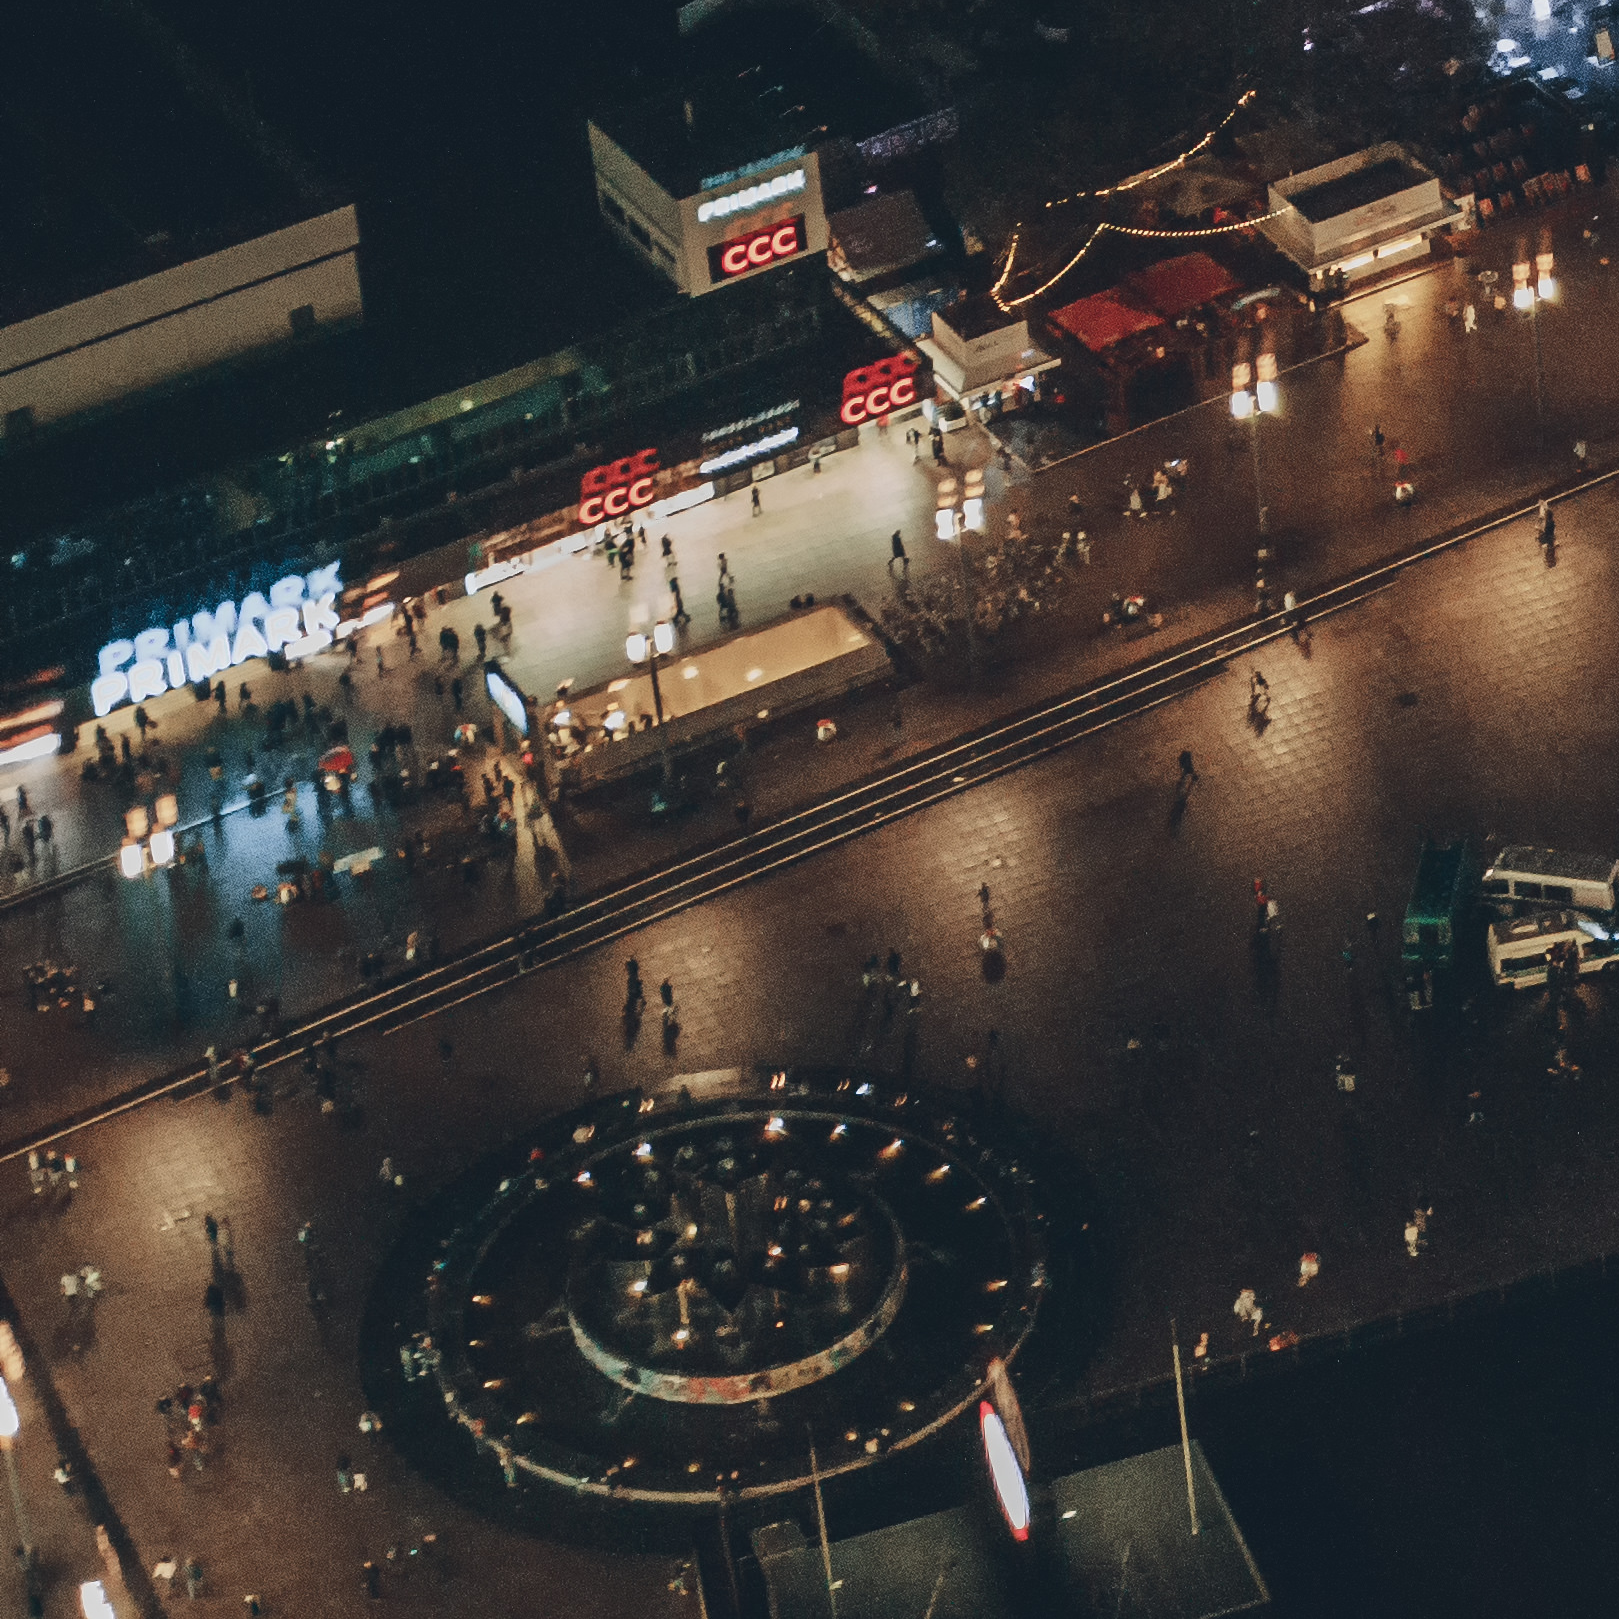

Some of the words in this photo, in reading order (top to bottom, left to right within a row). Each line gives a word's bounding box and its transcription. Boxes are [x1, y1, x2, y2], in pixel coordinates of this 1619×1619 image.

[722, 227, 797, 273] CCC
[842, 378, 915, 424] CCC
[578, 478, 654, 525] CCC
[91, 592, 341, 717] PRIMARK
